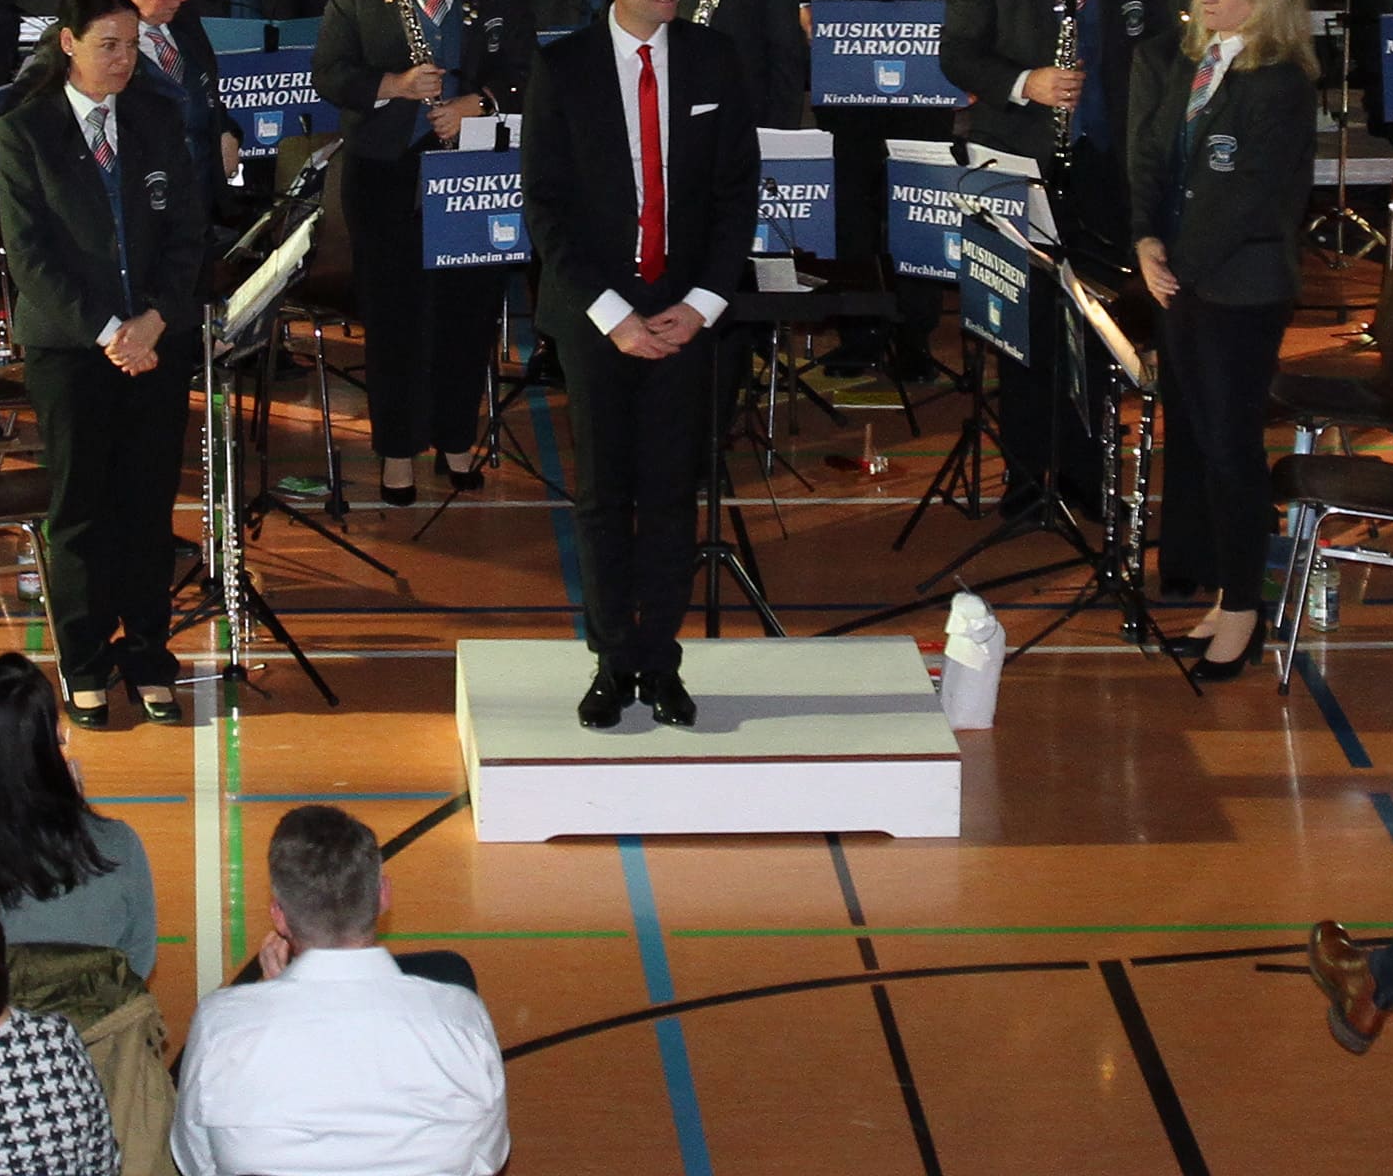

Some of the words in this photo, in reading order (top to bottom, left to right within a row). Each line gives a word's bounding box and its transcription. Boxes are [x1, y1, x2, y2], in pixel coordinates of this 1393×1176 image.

[815, 23, 943, 38] MUSIKVERE
[823, 94, 887, 104] Kirchheim
[890, 96, 908, 104] am
[911, 94, 957, 105] Neckar
[427, 174, 522, 195] MUSIKV
[446, 192, 523, 212] HARMO
[757, 203, 812, 218] ONIE
[908, 205, 963, 227] HARM
[435, 251, 502, 266] Kirchheim
[505, 252, 525, 261] am
[962, 238, 1026, 289] MUSIKVEREIN
[899, 261, 956, 279] Kirchheim
[969, 261, 1020, 304] HARMONIE
